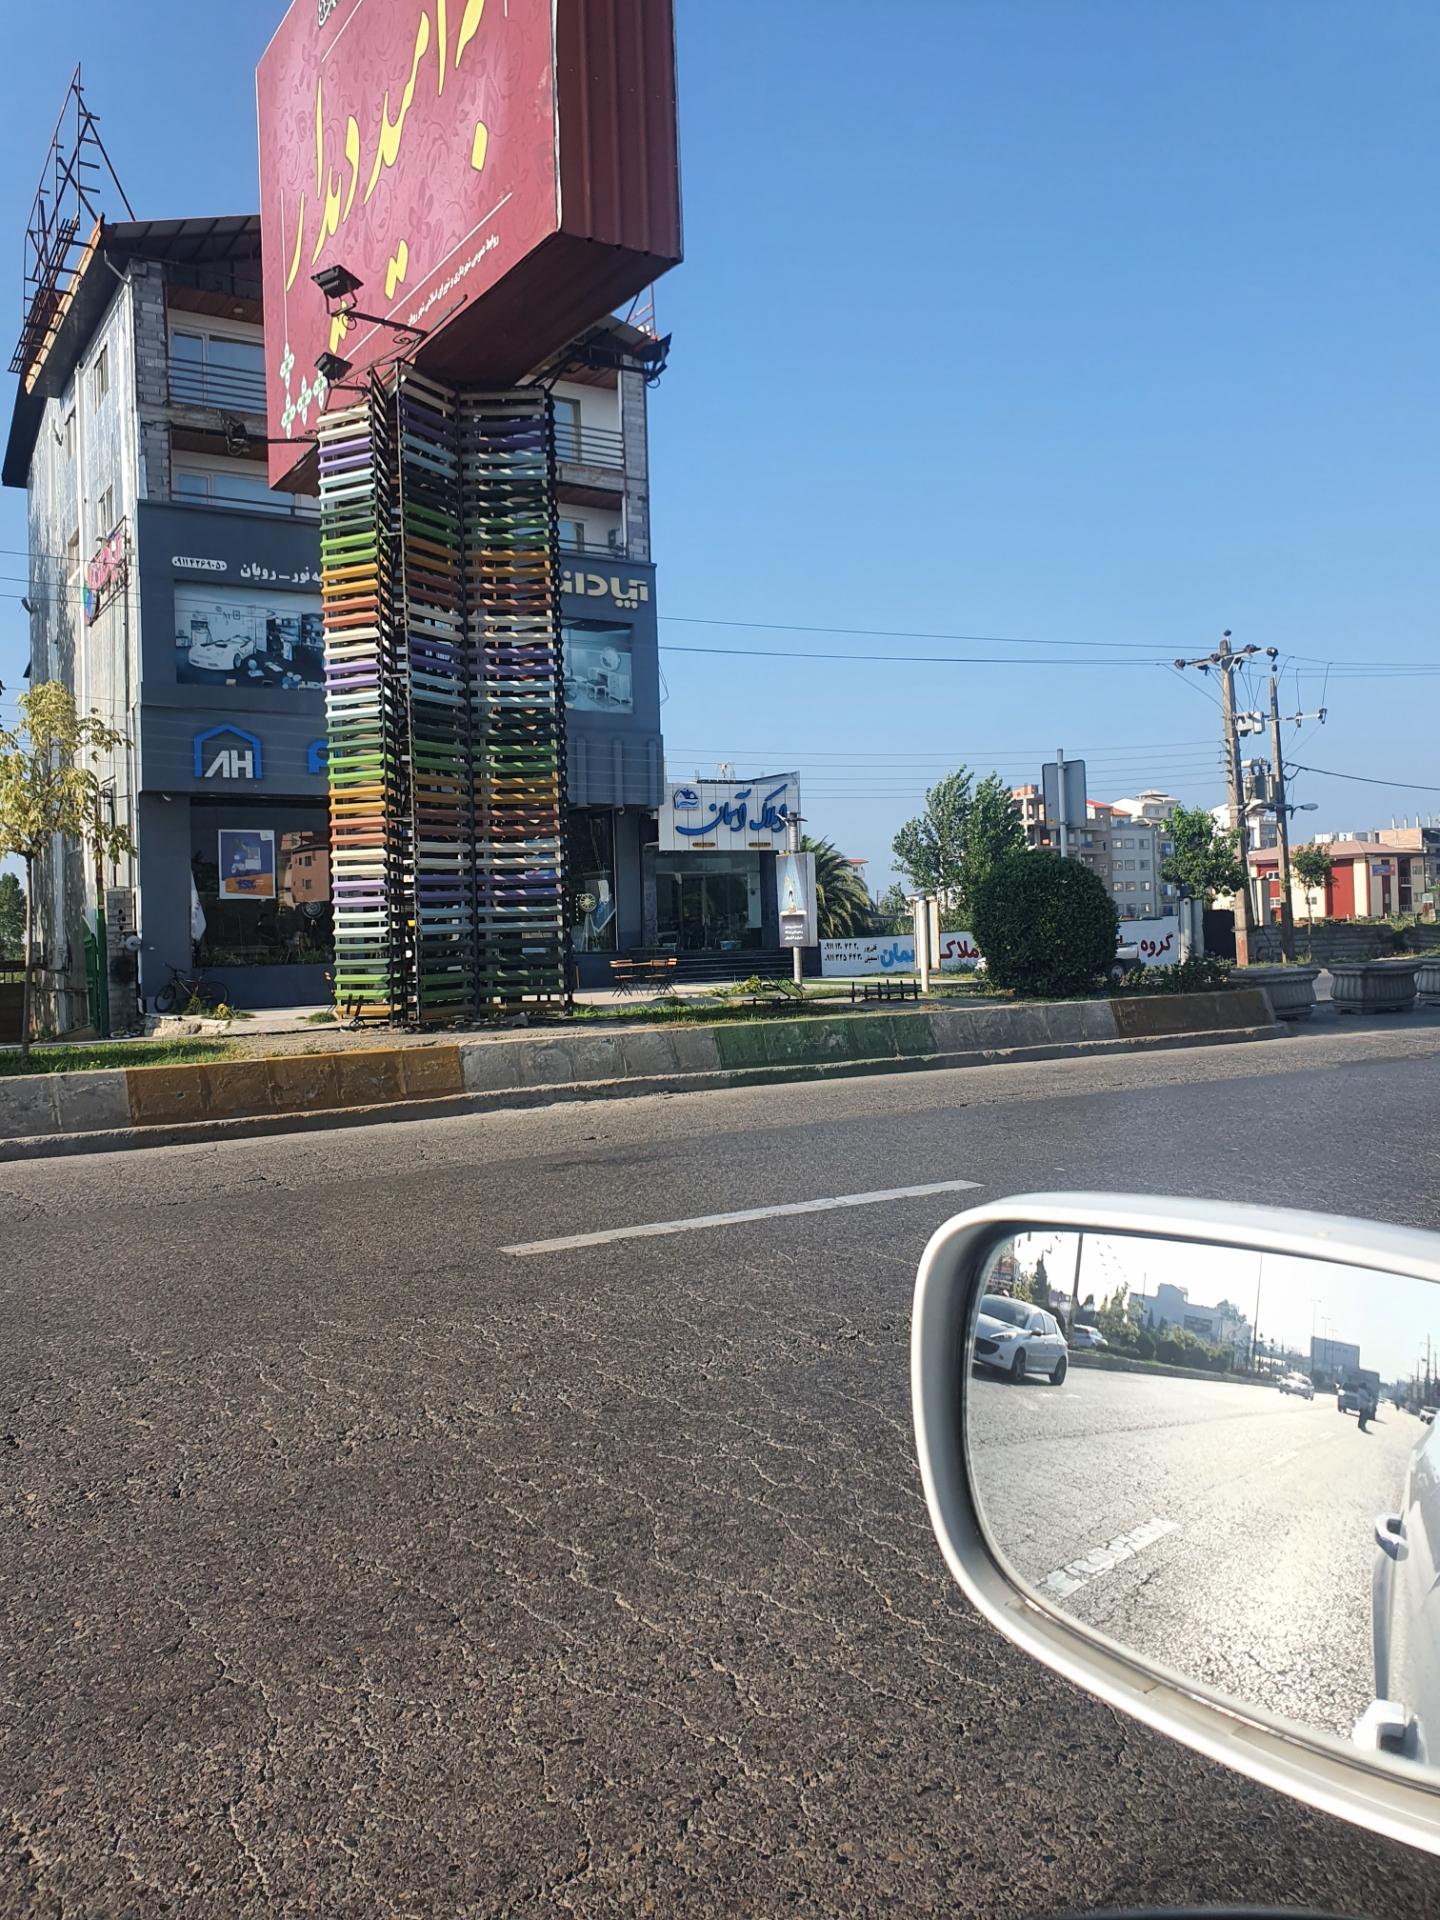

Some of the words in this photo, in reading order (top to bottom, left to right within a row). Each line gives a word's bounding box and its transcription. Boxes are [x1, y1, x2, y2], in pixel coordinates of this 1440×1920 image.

[240, 563, 277, 580] رویان
[291, 566, 310, 583] نور
[550, 570, 648, 609] آپادان
[204, 750, 254, 778] AH
[675, 788, 752, 836] آسمان
[880, 942, 915, 968] مان
[940, 940, 979, 959] ملاک
[1140, 931, 1174, 957] گروه
